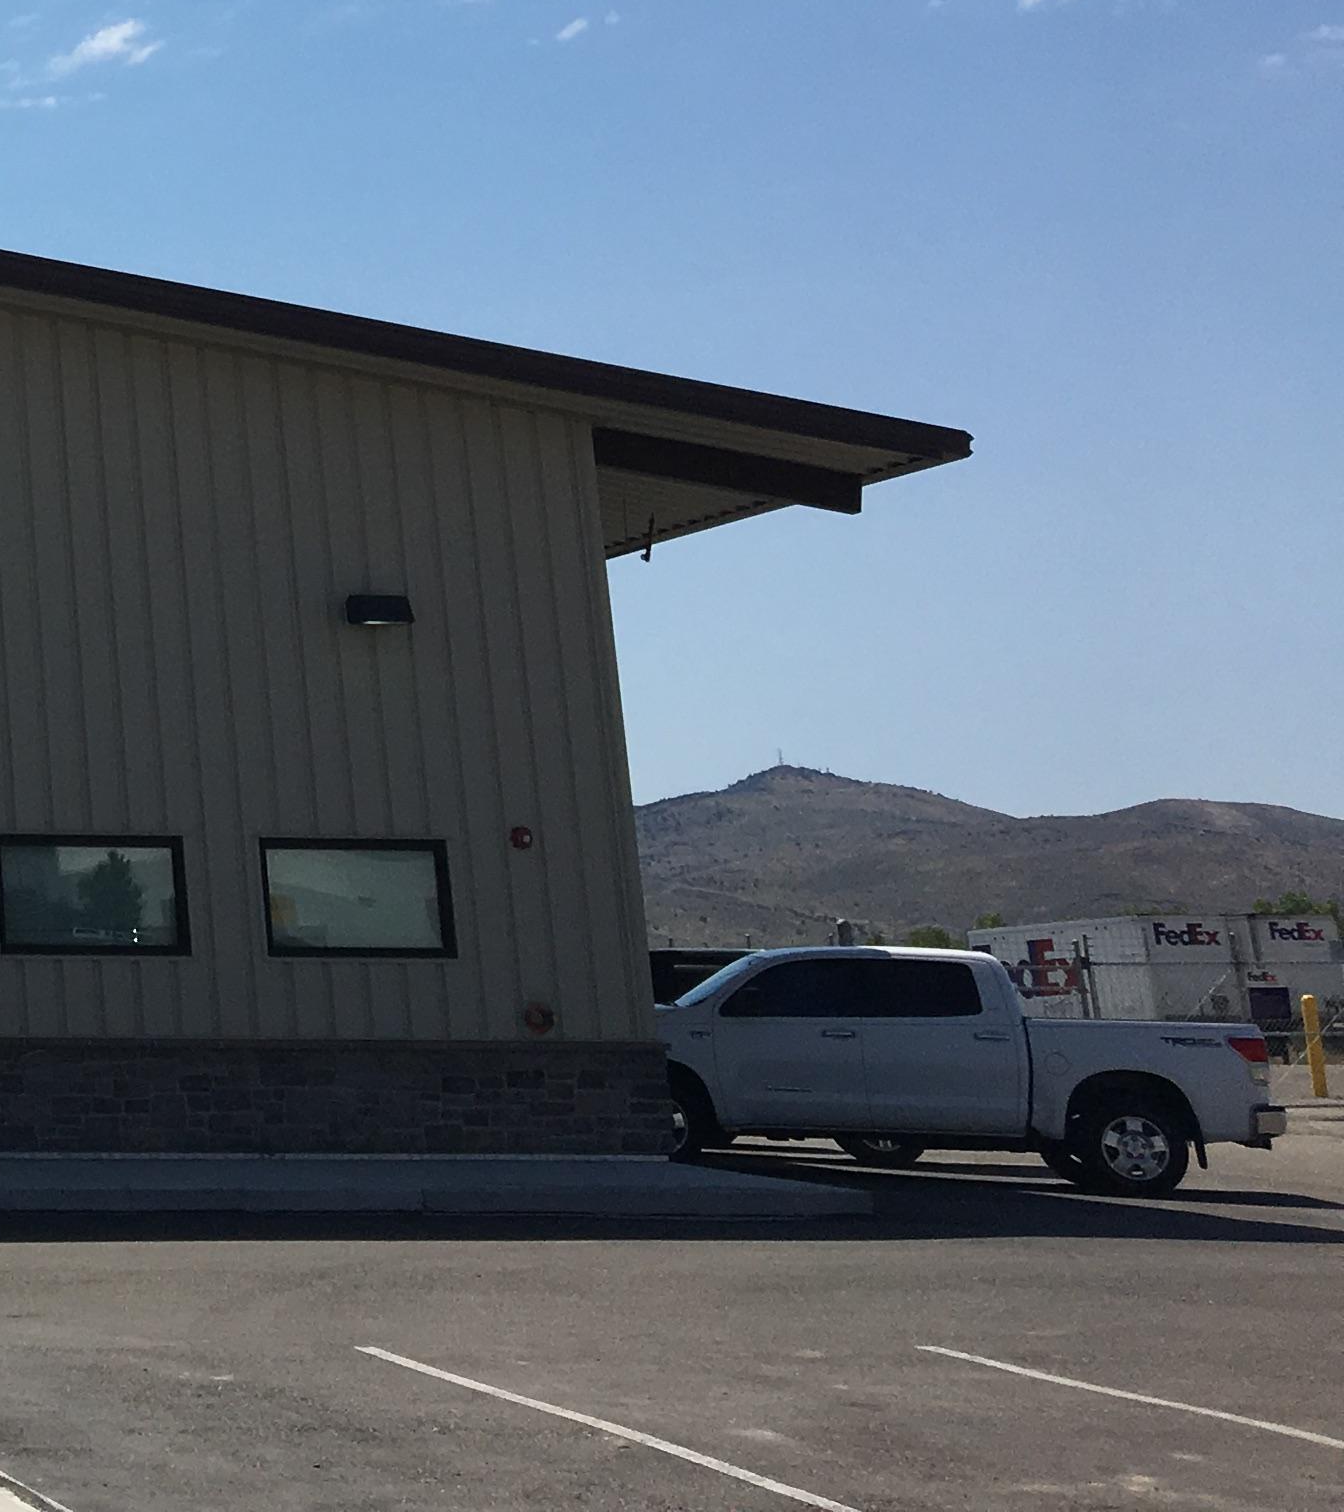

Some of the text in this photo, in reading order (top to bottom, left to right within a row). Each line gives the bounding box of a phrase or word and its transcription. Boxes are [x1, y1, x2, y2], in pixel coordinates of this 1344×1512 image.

[1153, 922, 1221, 946] FedEx
[1269, 921, 1325, 942] FedEx
[1247, 971, 1278, 982] FedEx
[1160, 1037, 1196, 1047] TRD
